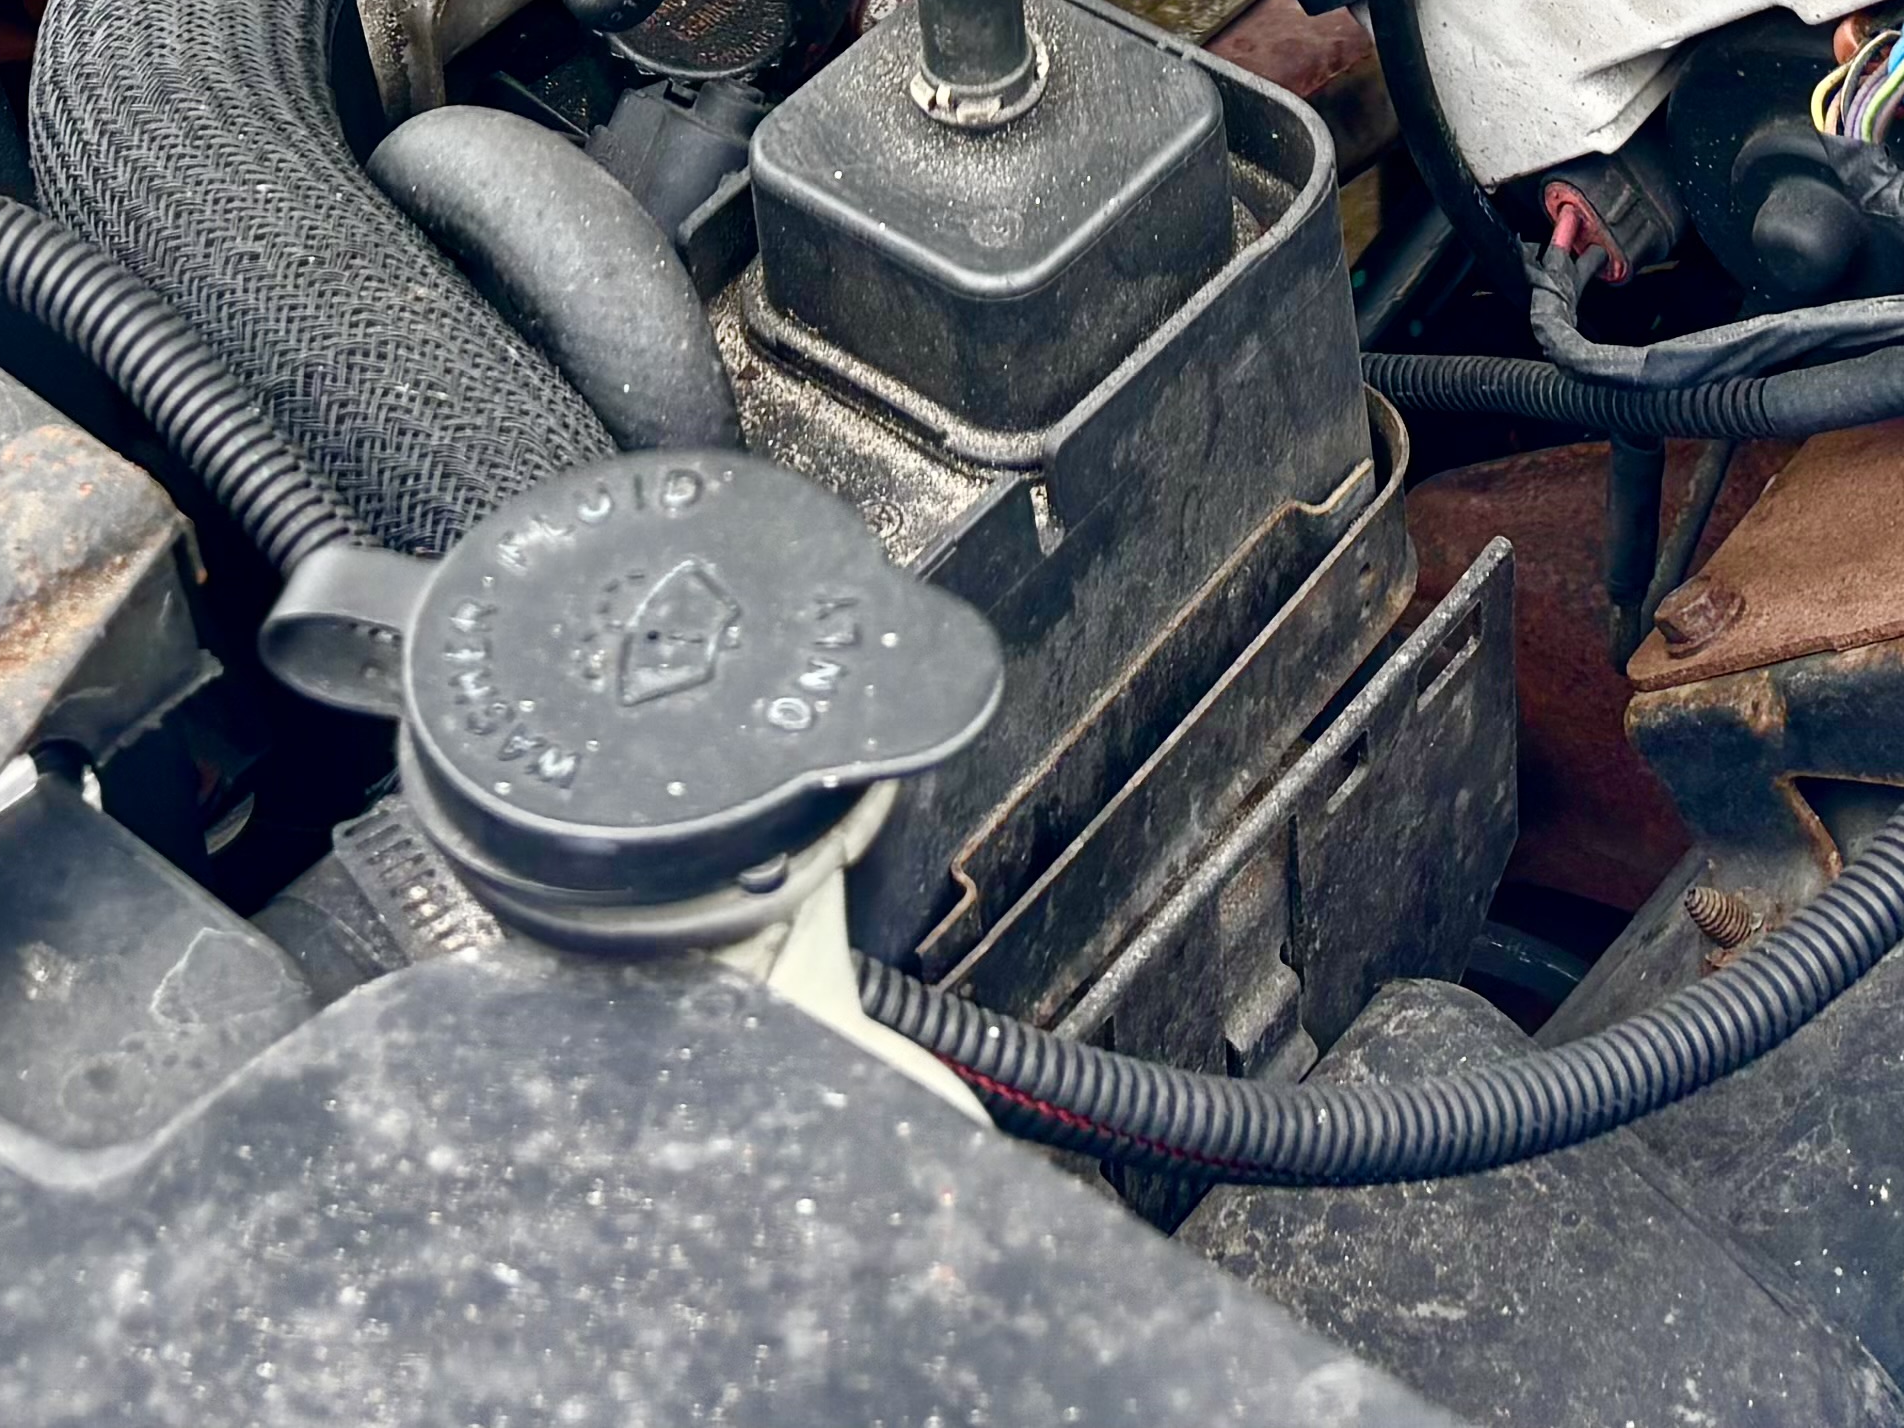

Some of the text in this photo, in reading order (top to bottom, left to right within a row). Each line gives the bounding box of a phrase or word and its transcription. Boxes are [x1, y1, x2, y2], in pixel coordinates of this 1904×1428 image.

[442, 467, 863, 789] WASHER FLUID ONLY
